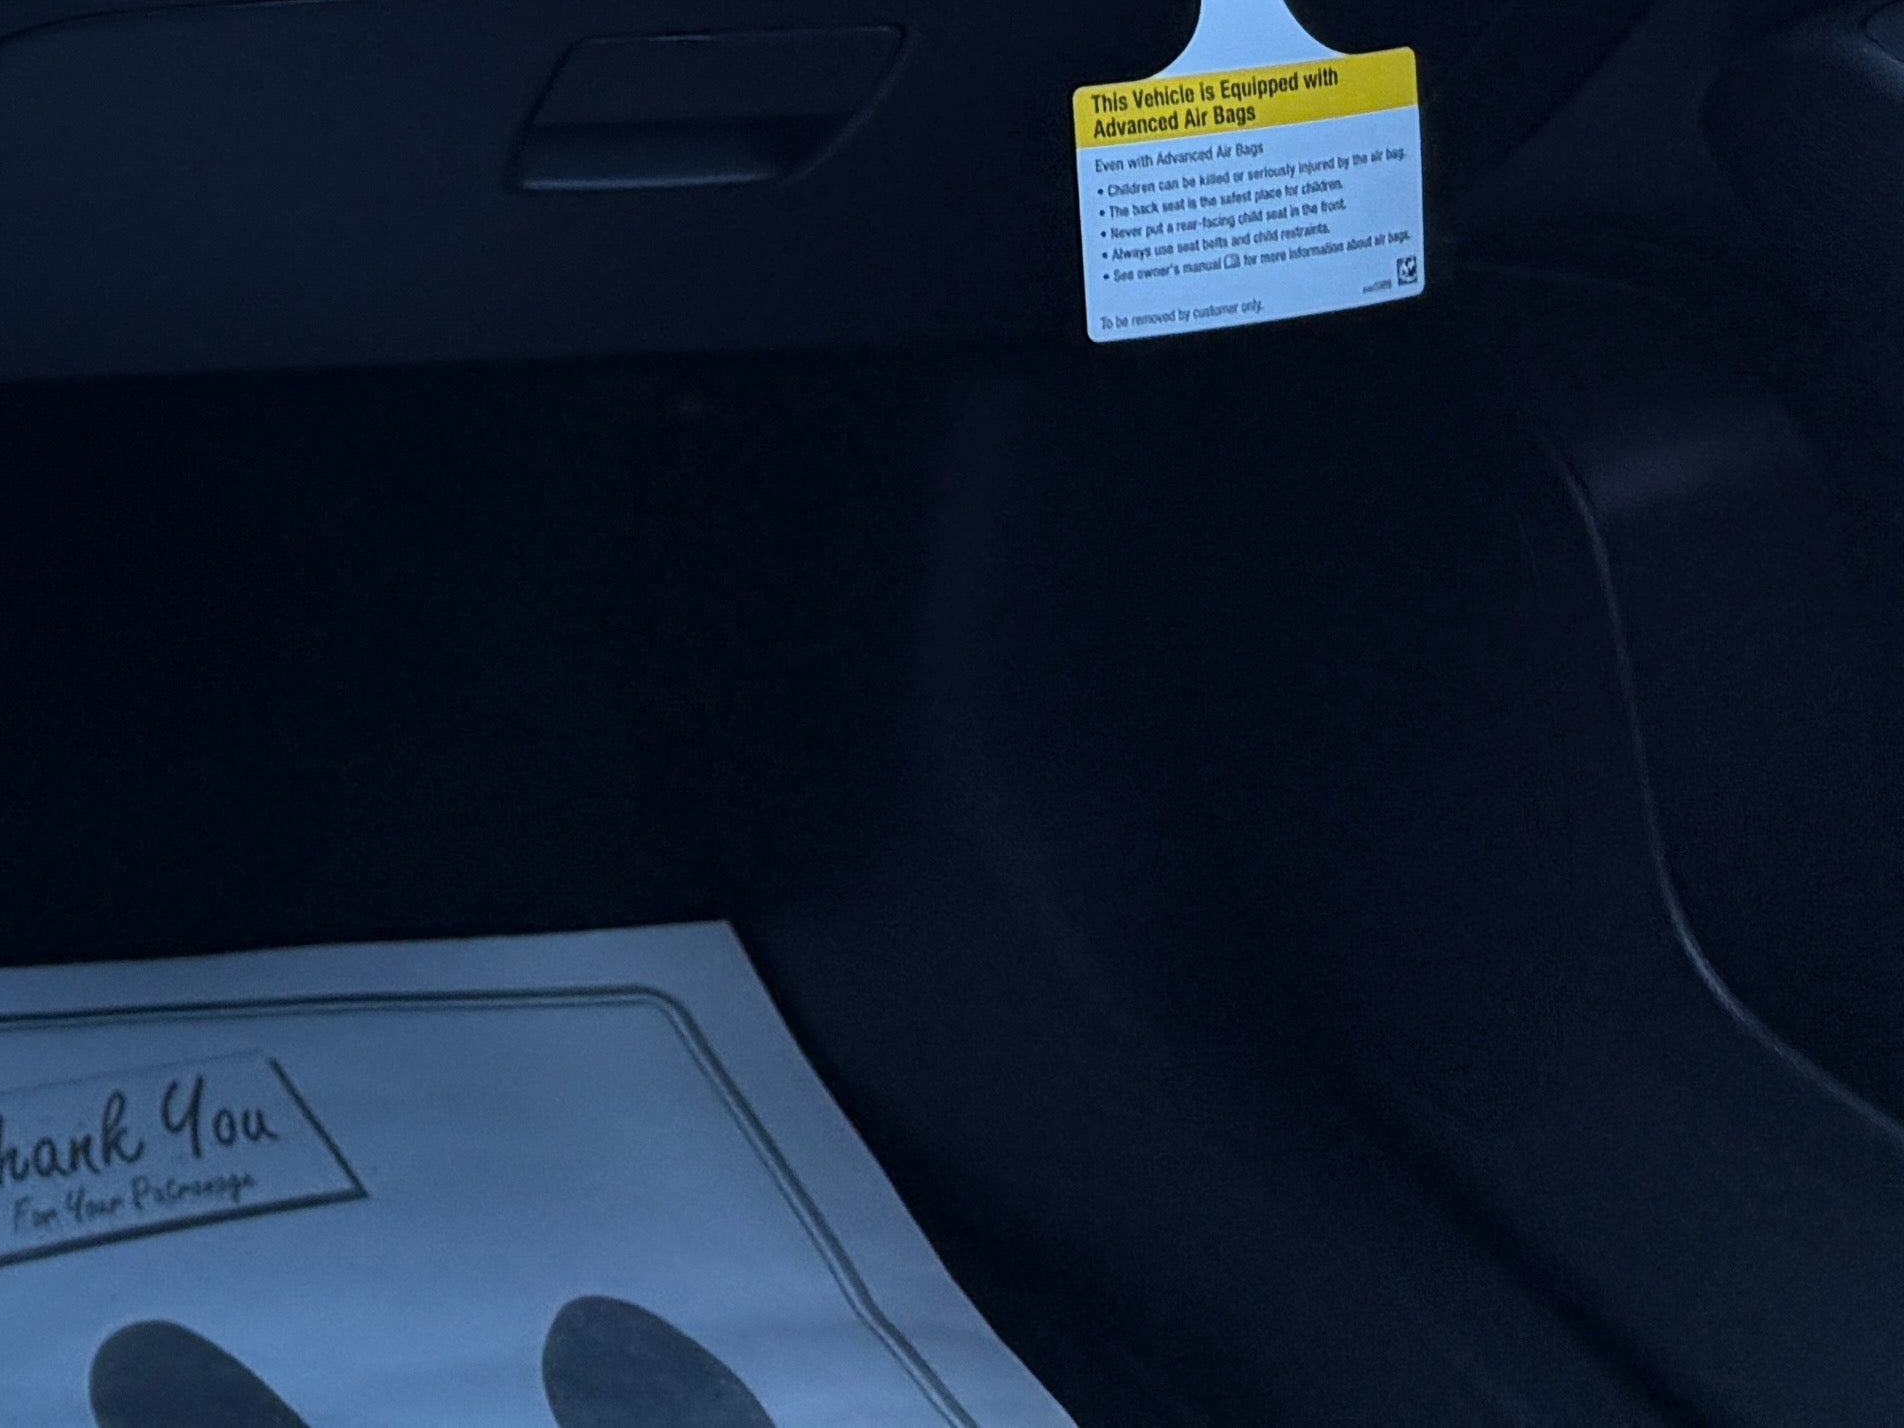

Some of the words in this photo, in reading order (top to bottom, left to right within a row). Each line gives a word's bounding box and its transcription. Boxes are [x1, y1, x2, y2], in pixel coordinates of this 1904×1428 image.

[1091, 90, 1128, 114] This
[1132, 85, 1195, 109] Vehicle
[1199, 81, 1215, 101] is
[1220, 72, 1298, 101] Equipped
[1303, 67, 1339, 89] with
[1093, 110, 1179, 139] Advanced
[1184, 108, 1208, 129] Air
[1213, 105, 1256, 127] Bags
[1095, 157, 1124, 173] Even
[1127, 153, 1154, 169] with
[1156, 145, 1213, 166] Advanced
[1216, 145, 1232, 159] Air
[1235, 142, 1264, 158] Bags
[1107, 181, 1156, 197] Children
[1158, 178, 1179, 190] can
[1182, 175, 1196, 189] be
[1199, 170, 1230, 187] killed
[1233, 170, 1245, 183] or
[1247, 162, 1297, 181] seriously
[1298, 156, 1336, 175] injured
[1337, 154, 1350, 170] by
[1352, 153, 1368, 167] the
[1370, 149, 1384, 162] air
[1109, 205, 1130, 219] The
[1132, 202, 1159, 217] back
[1162, 197, 1185, 212] seat
[1187, 196, 1198, 210] is
[1200, 194, 1217, 207] the
[1220, 188, 1253, 206] safest
[1254, 186, 1283, 204] place
[1284, 183, 1299, 197] for
[1110, 226, 1143, 240] Never
[1146, 222, 1164, 239] put
[1166, 222, 1175, 233] a
[1176, 213, 1236, 233] rear-facing
[1238, 209, 1264, 226] child
[1265, 206, 1288, 222] seat
[1289, 204, 1300, 218] in
[1301, 202, 1319, 216] the
[1111, 246, 1152, 261] Always
[1154, 243, 1175, 256] use
[1177, 239, 1201, 253] seat
[1202, 236, 1228, 251] belts
[1230, 232, 1252, 246] and
[1253, 229, 1279, 244] child
[1113, 268, 1135, 283] See
[1137, 263, 1181, 280] owner's
[1183, 258, 1221, 274] manual
[1243, 254, 1258, 267] for
[1260, 250, 1287, 264] more
[1288, 242, 1344, 261] information
[1346, 236, 1373, 252] about
[1374, 234, 1387, 246] air
[1100, 316, 1115, 331] To
[1116, 316, 1129, 330] be
[1131, 310, 1177, 326] removed
[1178, 308, 1191, 325] by
[1192, 302, 1240, 321] customer
[160, 1074, 278, 1158] You
[12, 1196, 60, 1231] For
[65, 1188, 124, 1221] Your
[129, 1169, 258, 1210] Patronage
